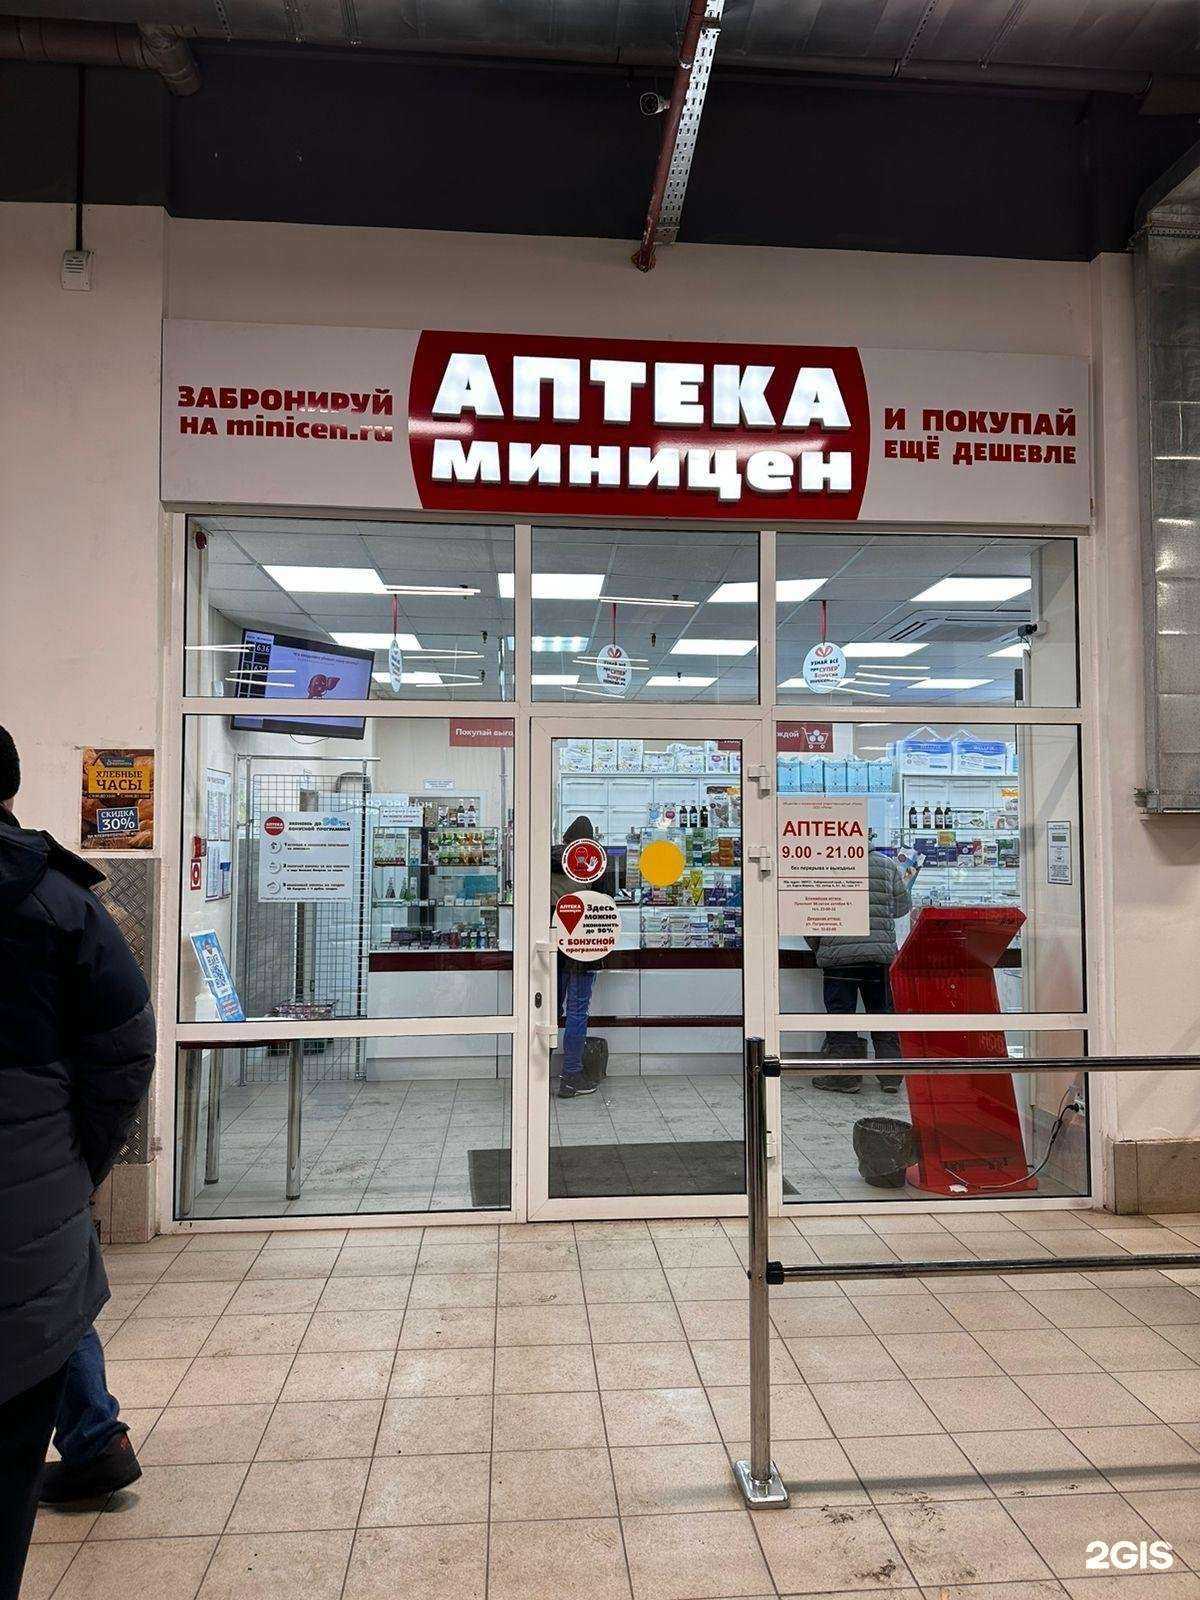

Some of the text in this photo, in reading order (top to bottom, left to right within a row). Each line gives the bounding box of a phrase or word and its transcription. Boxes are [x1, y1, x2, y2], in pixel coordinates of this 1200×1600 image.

[432, 352, 852, 429] АПТЕКА
[178, 385, 394, 416] ЗАБРОНИРУЙ
[179, 414, 394, 443] НА minicen.ru
[884, 407, 1077, 437] И ПОКУПАЙ
[884, 436, 1077, 466] ЕЩЁ ДЕШЕВЛЕ
[455, 727, 492, 739] Покупай
[96, 770, 143, 778] ХЛЕБНЫЕ
[96, 779, 144, 791] ЧАСЫ
[101, 809, 135, 819] СКИДКА
[102, 816, 136, 831] 30%
[782, 820, 864, 837] АПТЕКА
[782, 845, 812, 859] 9.00
[826, 845, 865, 859] 21.00
[586, 903, 615, 913] Здесь
[567, 936, 615, 946] БОНУСНОЙ
